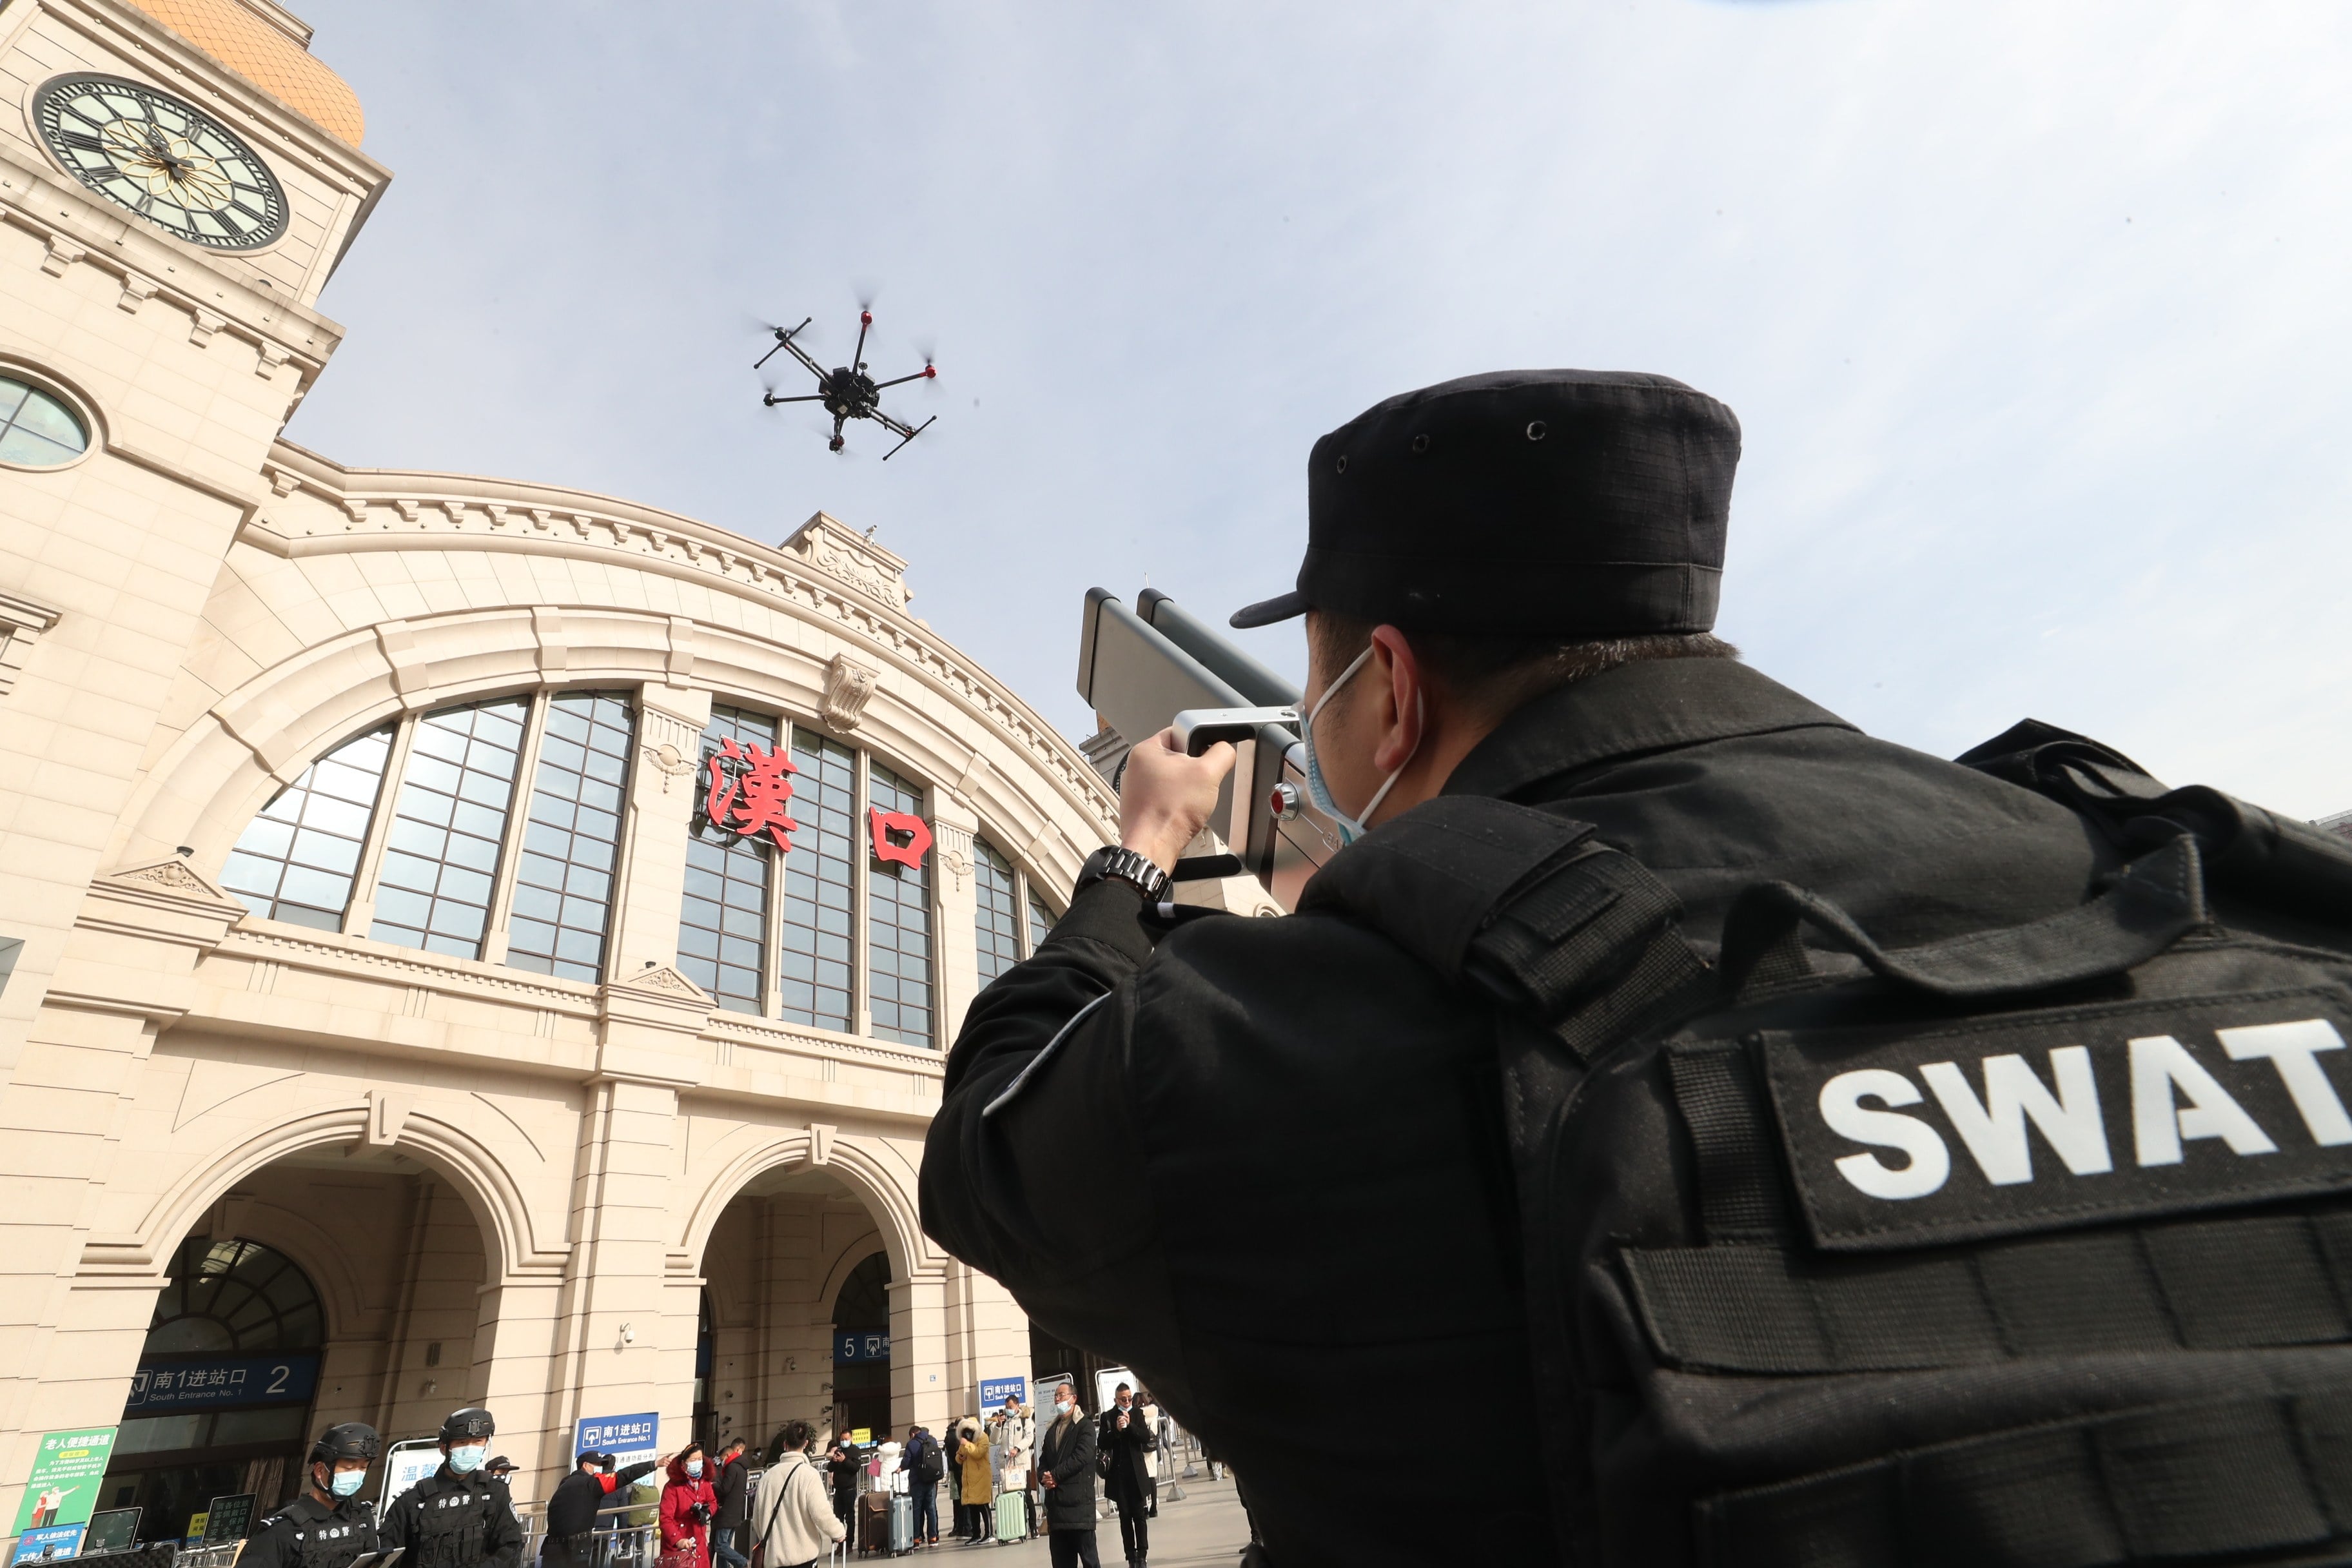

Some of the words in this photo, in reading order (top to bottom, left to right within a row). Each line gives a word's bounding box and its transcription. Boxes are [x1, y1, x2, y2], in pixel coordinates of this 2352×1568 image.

[1819, 1019, 2352, 1200] SWAT
[845, 1338, 854, 1357] 5
[153, 1369, 246, 1389] 南1进站口
[266, 1366, 289, 1393] 2
[149, 1393, 174, 1401] South
[179, 1391, 215, 1400] Entrance
[219, 1389, 233, 1397] No.
[995, 1384, 1021, 1394] 南1进站口
[603, 1422, 651, 1438] 南1进站口
[44, 1434, 110, 1450] 老人便捷通道
[35, 1529, 77, 1541] 军人依法优先
[18, 1547, 72, 1562] 工作人通道
